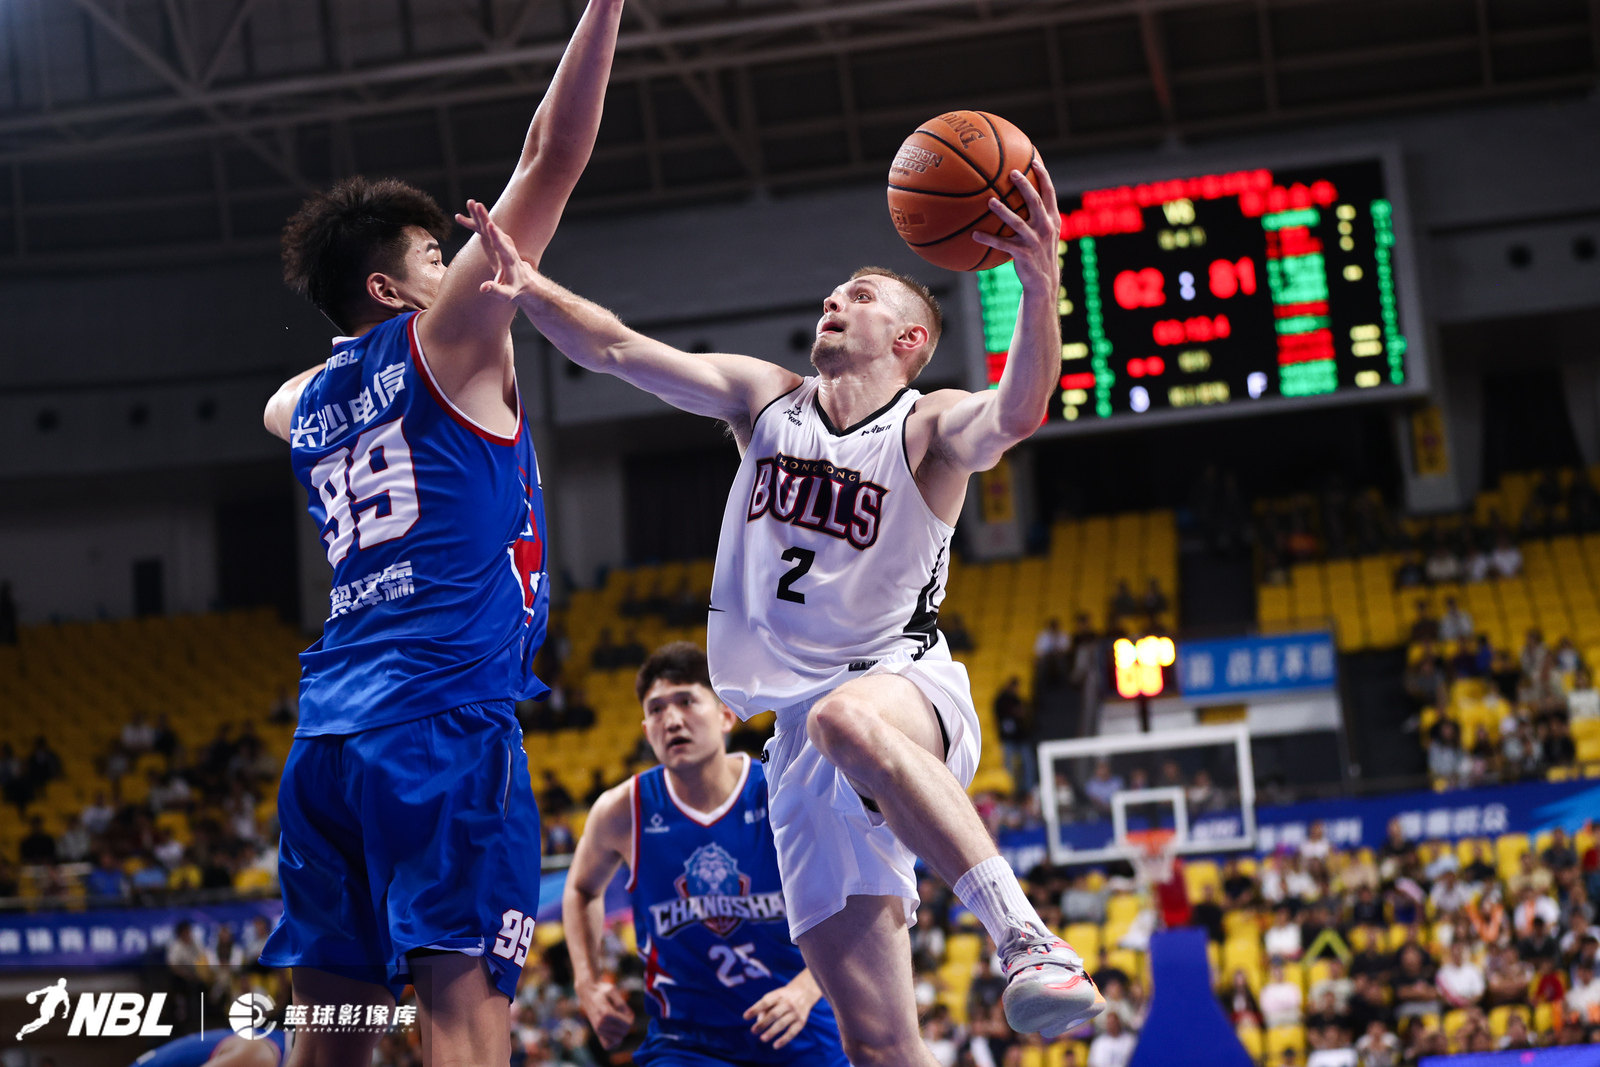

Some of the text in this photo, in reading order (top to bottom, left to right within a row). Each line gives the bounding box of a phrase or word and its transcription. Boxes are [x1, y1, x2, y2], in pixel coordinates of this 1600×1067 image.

[328, 349, 359, 371] NBL
[290, 361, 406, 449] 长沙电信
[310, 415, 422, 570] 99
[749, 461, 882, 548] BULLS
[776, 547, 816, 604] 2
[492, 908, 536, 968] 99
[649, 892, 788, 938] CHANGSHA
[708, 943, 772, 988] 25
